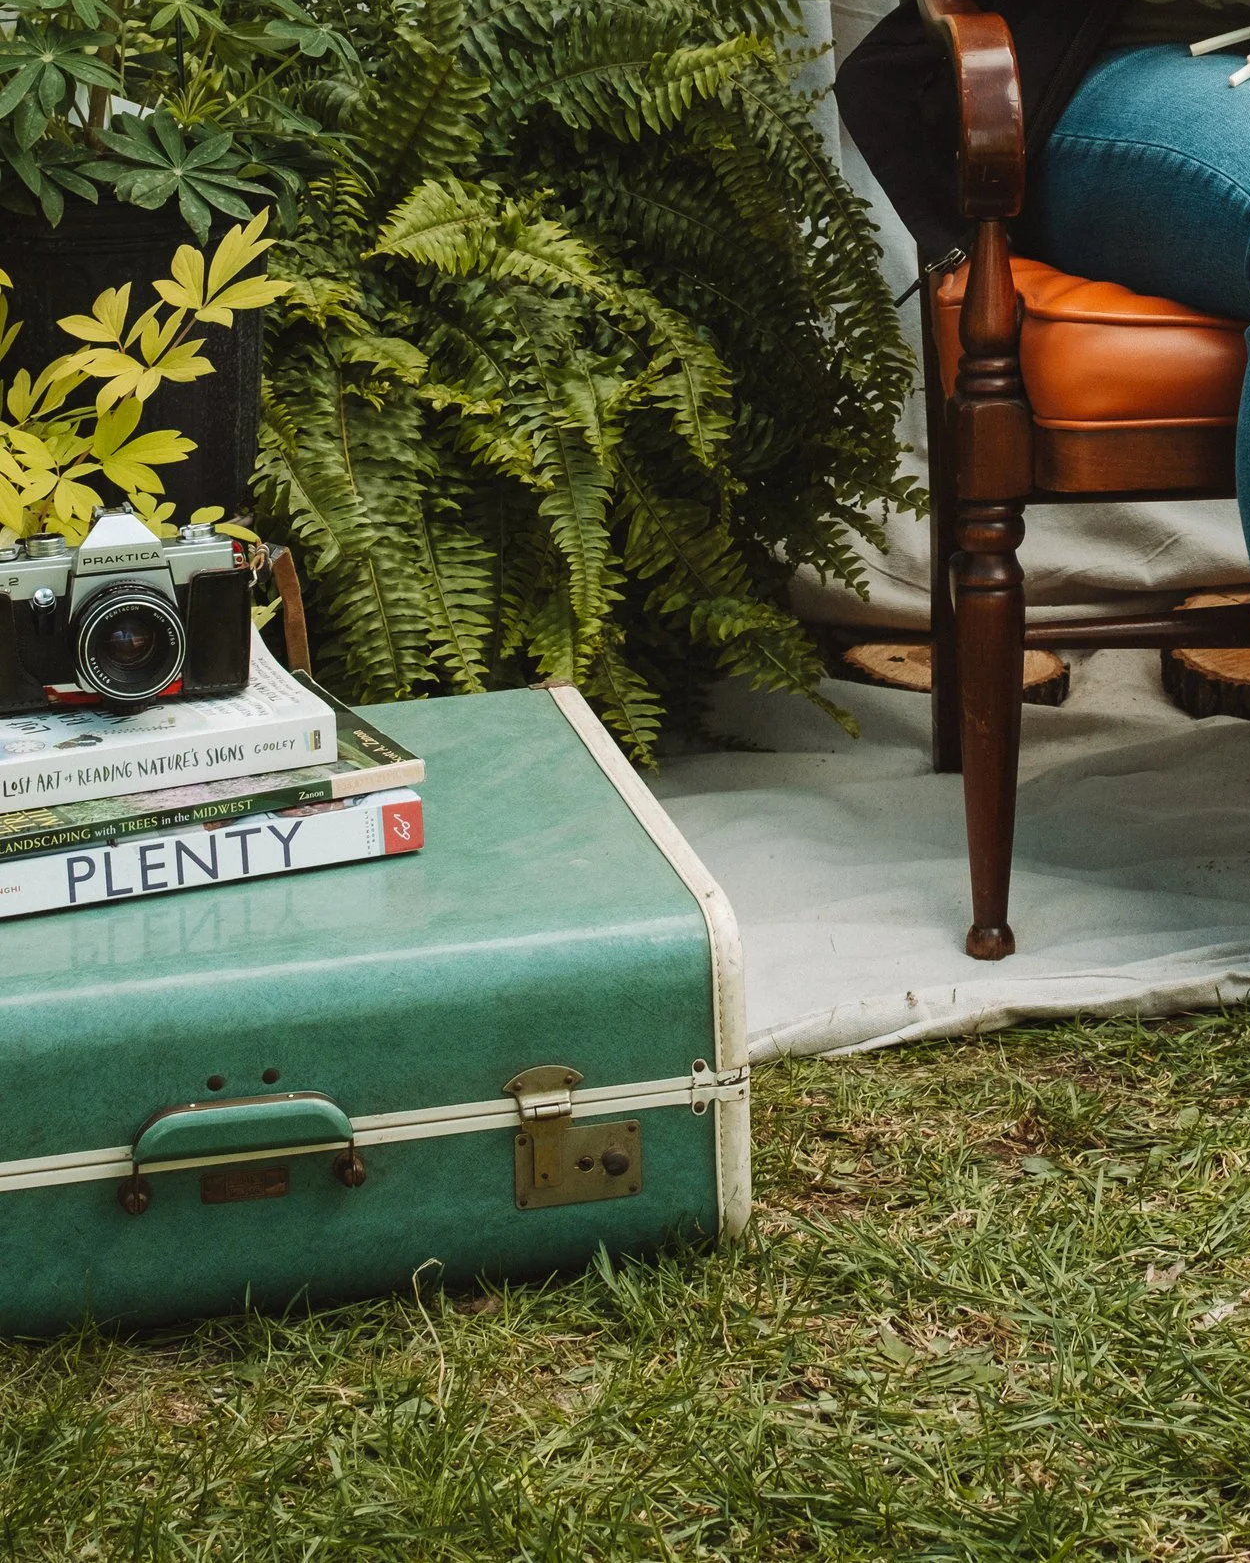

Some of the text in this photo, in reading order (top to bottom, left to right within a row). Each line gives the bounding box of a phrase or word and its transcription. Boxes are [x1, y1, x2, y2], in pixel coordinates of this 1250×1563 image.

[83, 551, 160, 566] PRAKTICA
[105, 605, 140, 620] PENTACON
[36, 770, 62, 793] ART
[77, 761, 133, 786] READING
[137, 748, 200, 778] NATURE'S
[206, 744, 245, 766] SIGNS
[254, 739, 296, 754] GOOLEY
[94, 825, 117, 838] with
[118, 817, 158, 833] TREES
[161, 816, 171, 825] in
[174, 812, 190, 823] the
[193, 799, 254, 820] MIDWEST
[298, 789, 325, 801] Zanon
[66, 820, 303, 903] PLENTY
